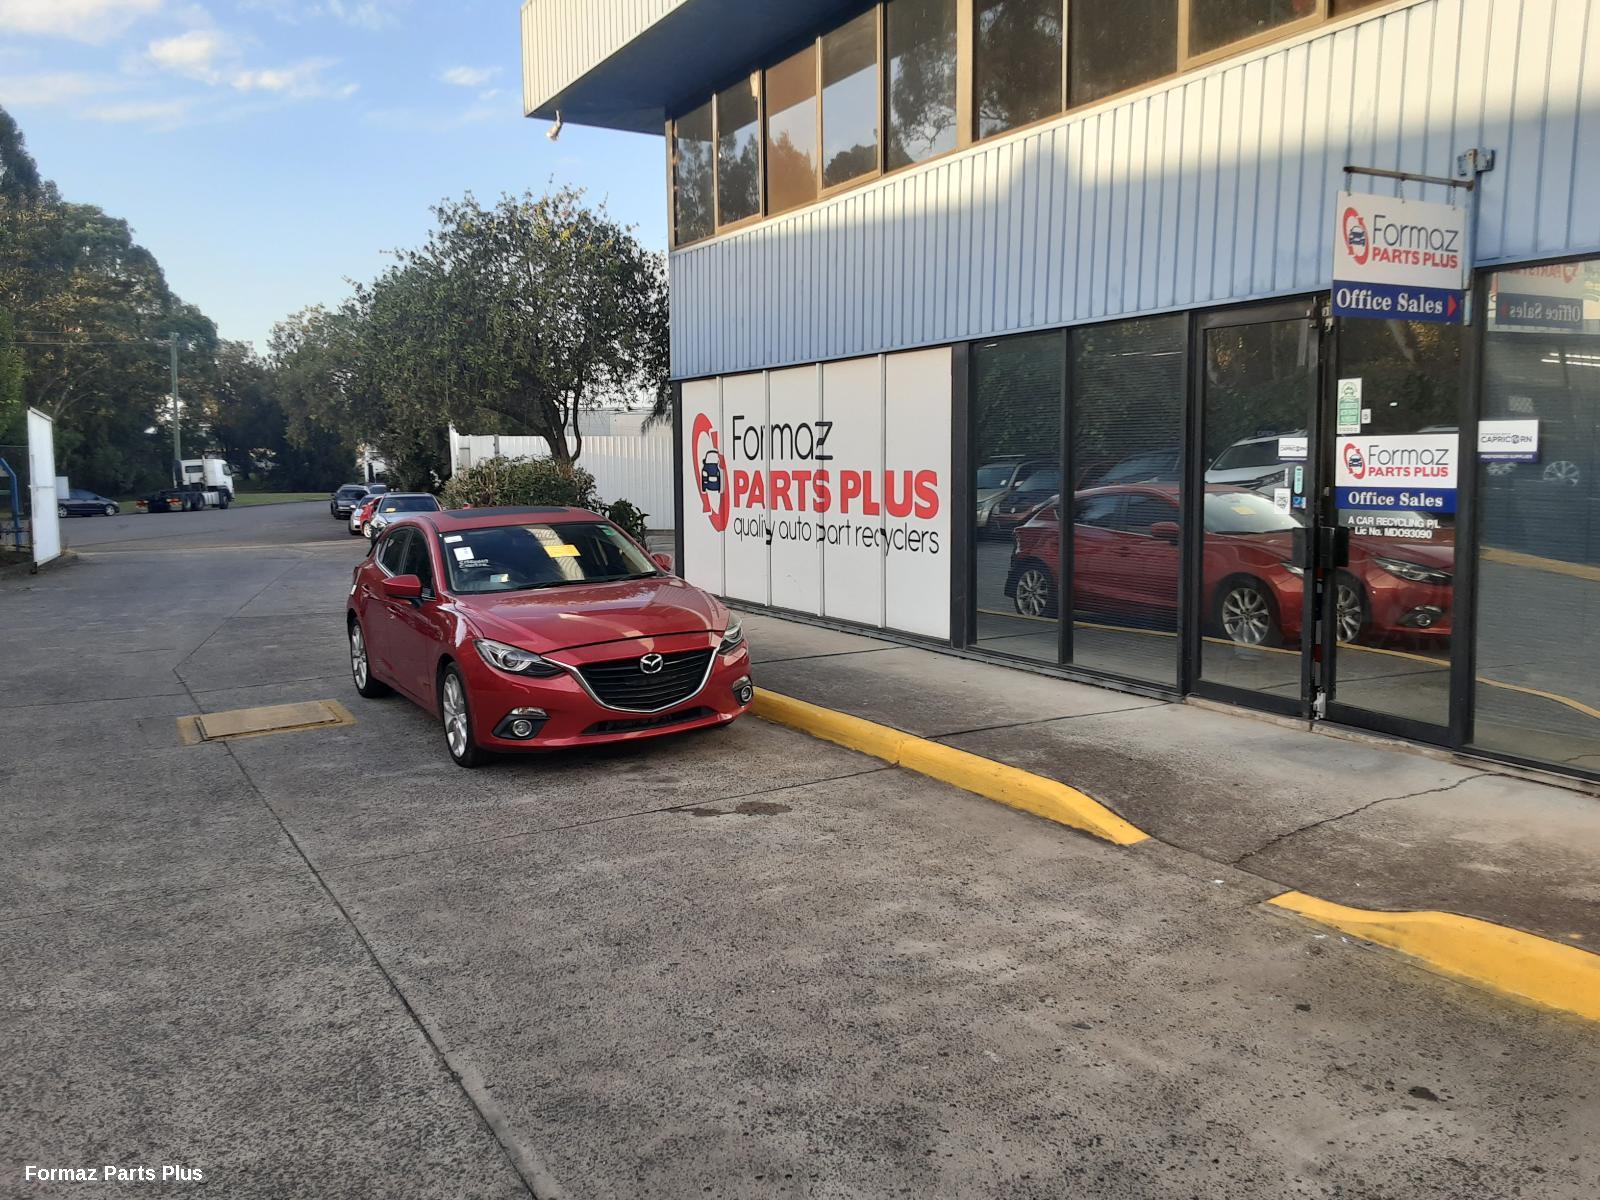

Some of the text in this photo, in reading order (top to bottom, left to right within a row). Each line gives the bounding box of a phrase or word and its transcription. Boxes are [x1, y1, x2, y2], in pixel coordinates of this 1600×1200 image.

[1372, 214, 1458, 253] Formaz
[1371, 246, 1458, 269] PARTS PLUS
[1336, 288, 1443, 314] Office Sales
[732, 415, 833, 461] Formaz
[1368, 445, 1449, 466] Formaz
[1368, 466, 1449, 477] PARTS PLUS
[733, 469, 940, 520] PARTS PLUS
[1348, 491, 1443, 507] Office Sales
[1348, 516, 1355, 525] A
[1356, 516, 1374, 526] CAR
[1376, 517, 1425, 529] RECYCLING
[1355, 526, 1367, 535] Lic
[778, 516, 812, 542] auto
[815, 518, 851, 549] part
[855, 521, 940, 557] recyclers
